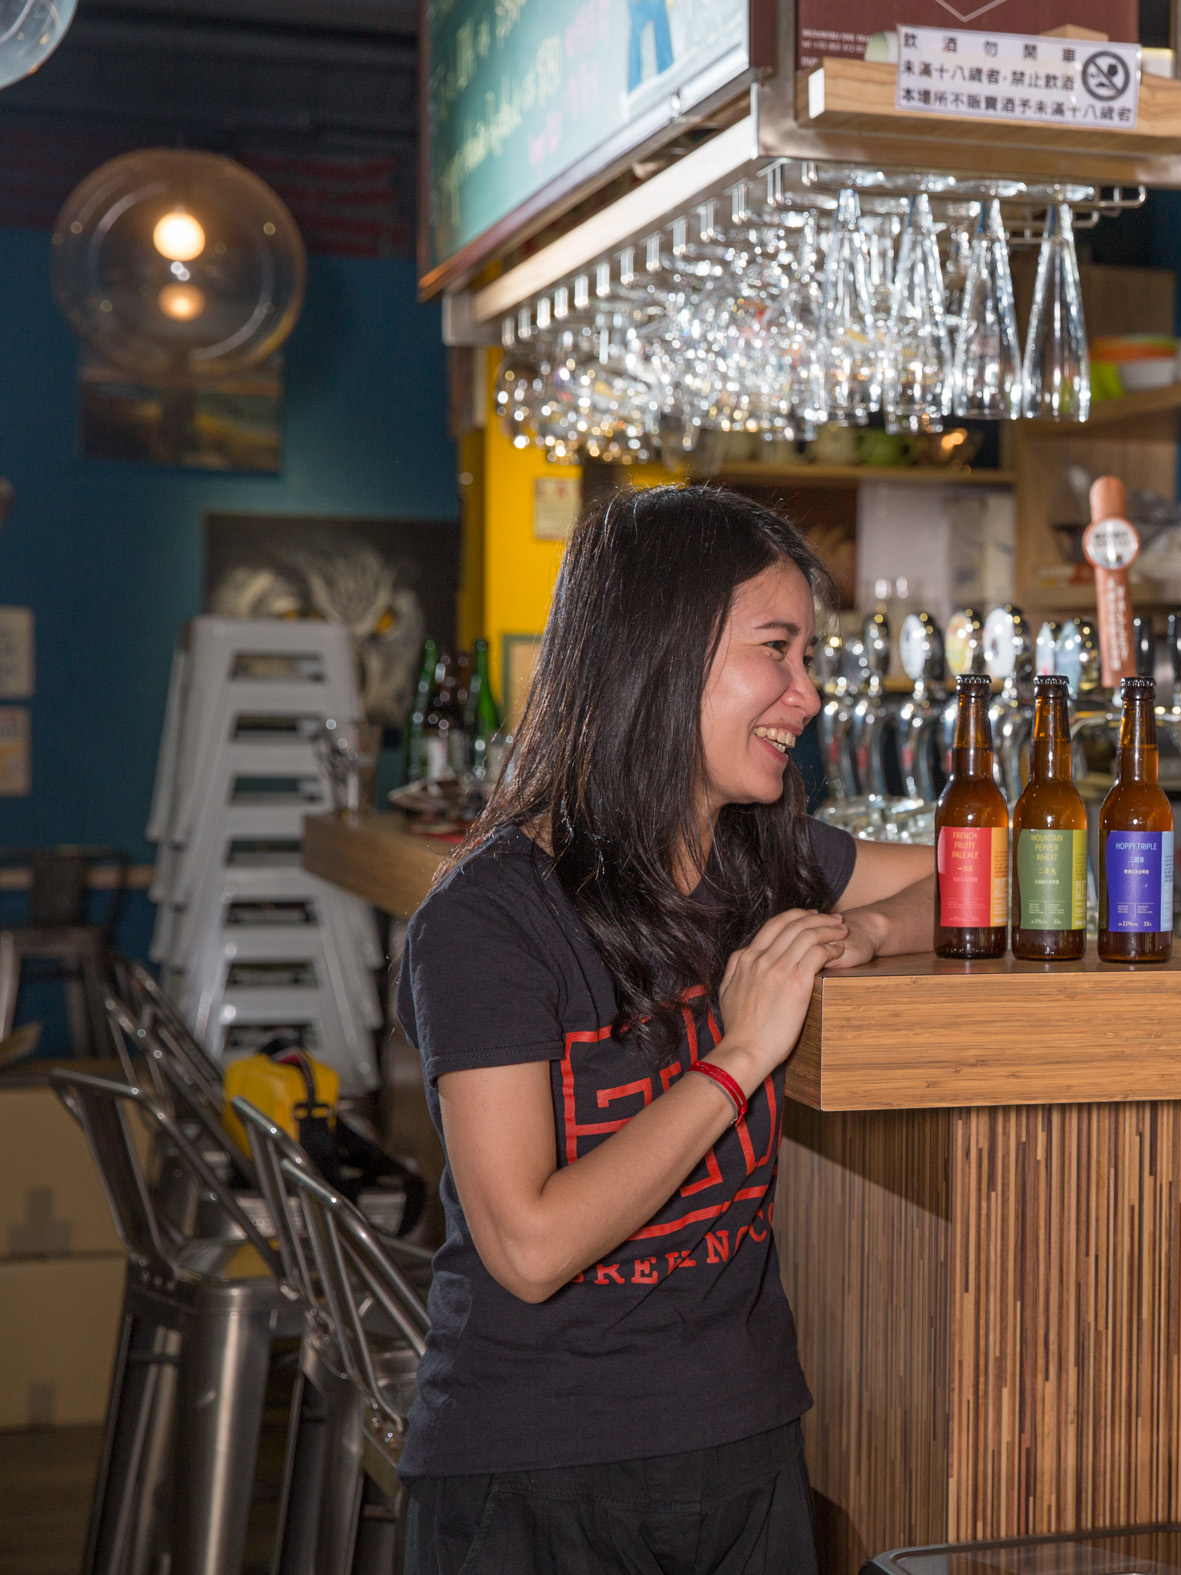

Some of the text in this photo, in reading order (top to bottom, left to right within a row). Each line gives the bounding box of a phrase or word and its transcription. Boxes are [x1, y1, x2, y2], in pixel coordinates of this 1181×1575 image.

[953, 831, 978, 840] FRENCH
[1031, 833, 1064, 842] MOUNTAIN
[954, 841, 976, 849] FRUITY
[1034, 843, 1059, 852] PEPPER
[1115, 842, 1158, 851] HOPPY TRIPLE
[952, 850, 979, 859] PALE ALE
[1036, 853, 1058, 861] WHEAT
